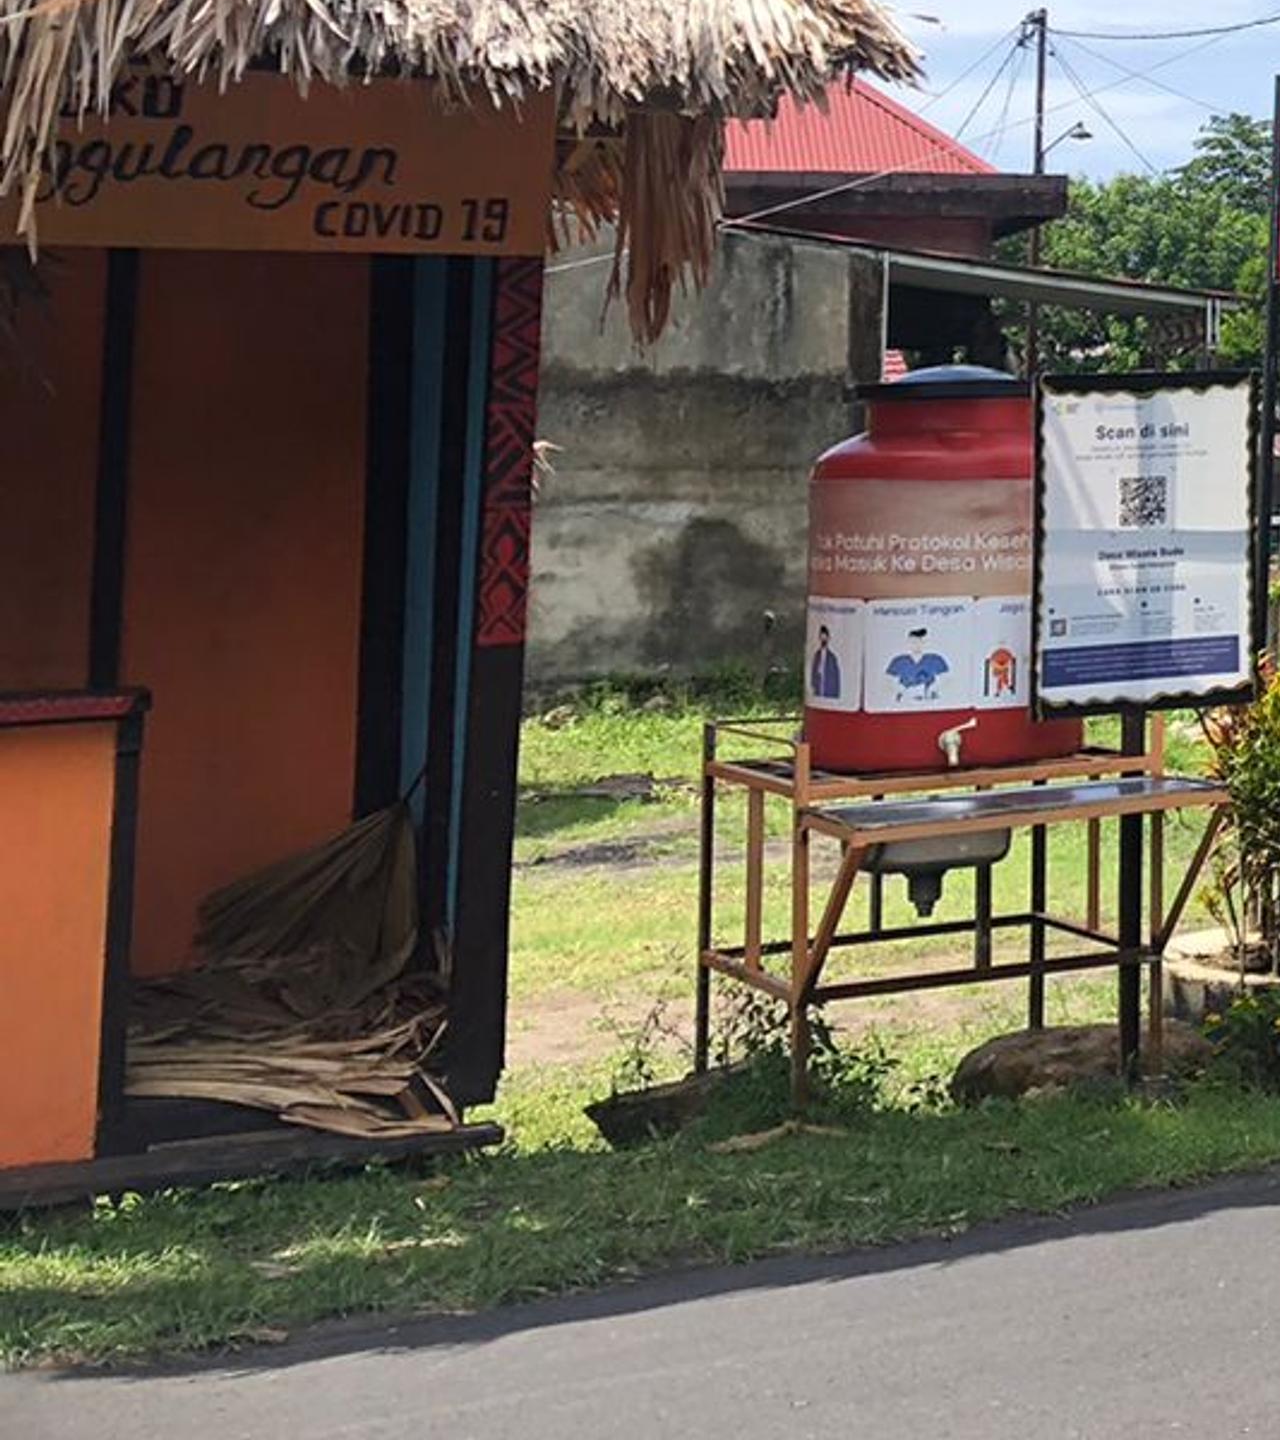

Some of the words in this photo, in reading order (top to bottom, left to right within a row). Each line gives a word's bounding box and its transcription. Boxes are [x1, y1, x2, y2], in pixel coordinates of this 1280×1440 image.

[312, 200, 443, 240] COVID
[460, 199, 510, 242] 19
[1096, 425, 1135, 440] Scan
[1140, 424, 1155, 438] di
[1161, 422, 1189, 437] sini
[888, 533, 971, 551] Protokol
[891, 555, 916, 571] Ke
[921, 555, 976, 571] Desa
